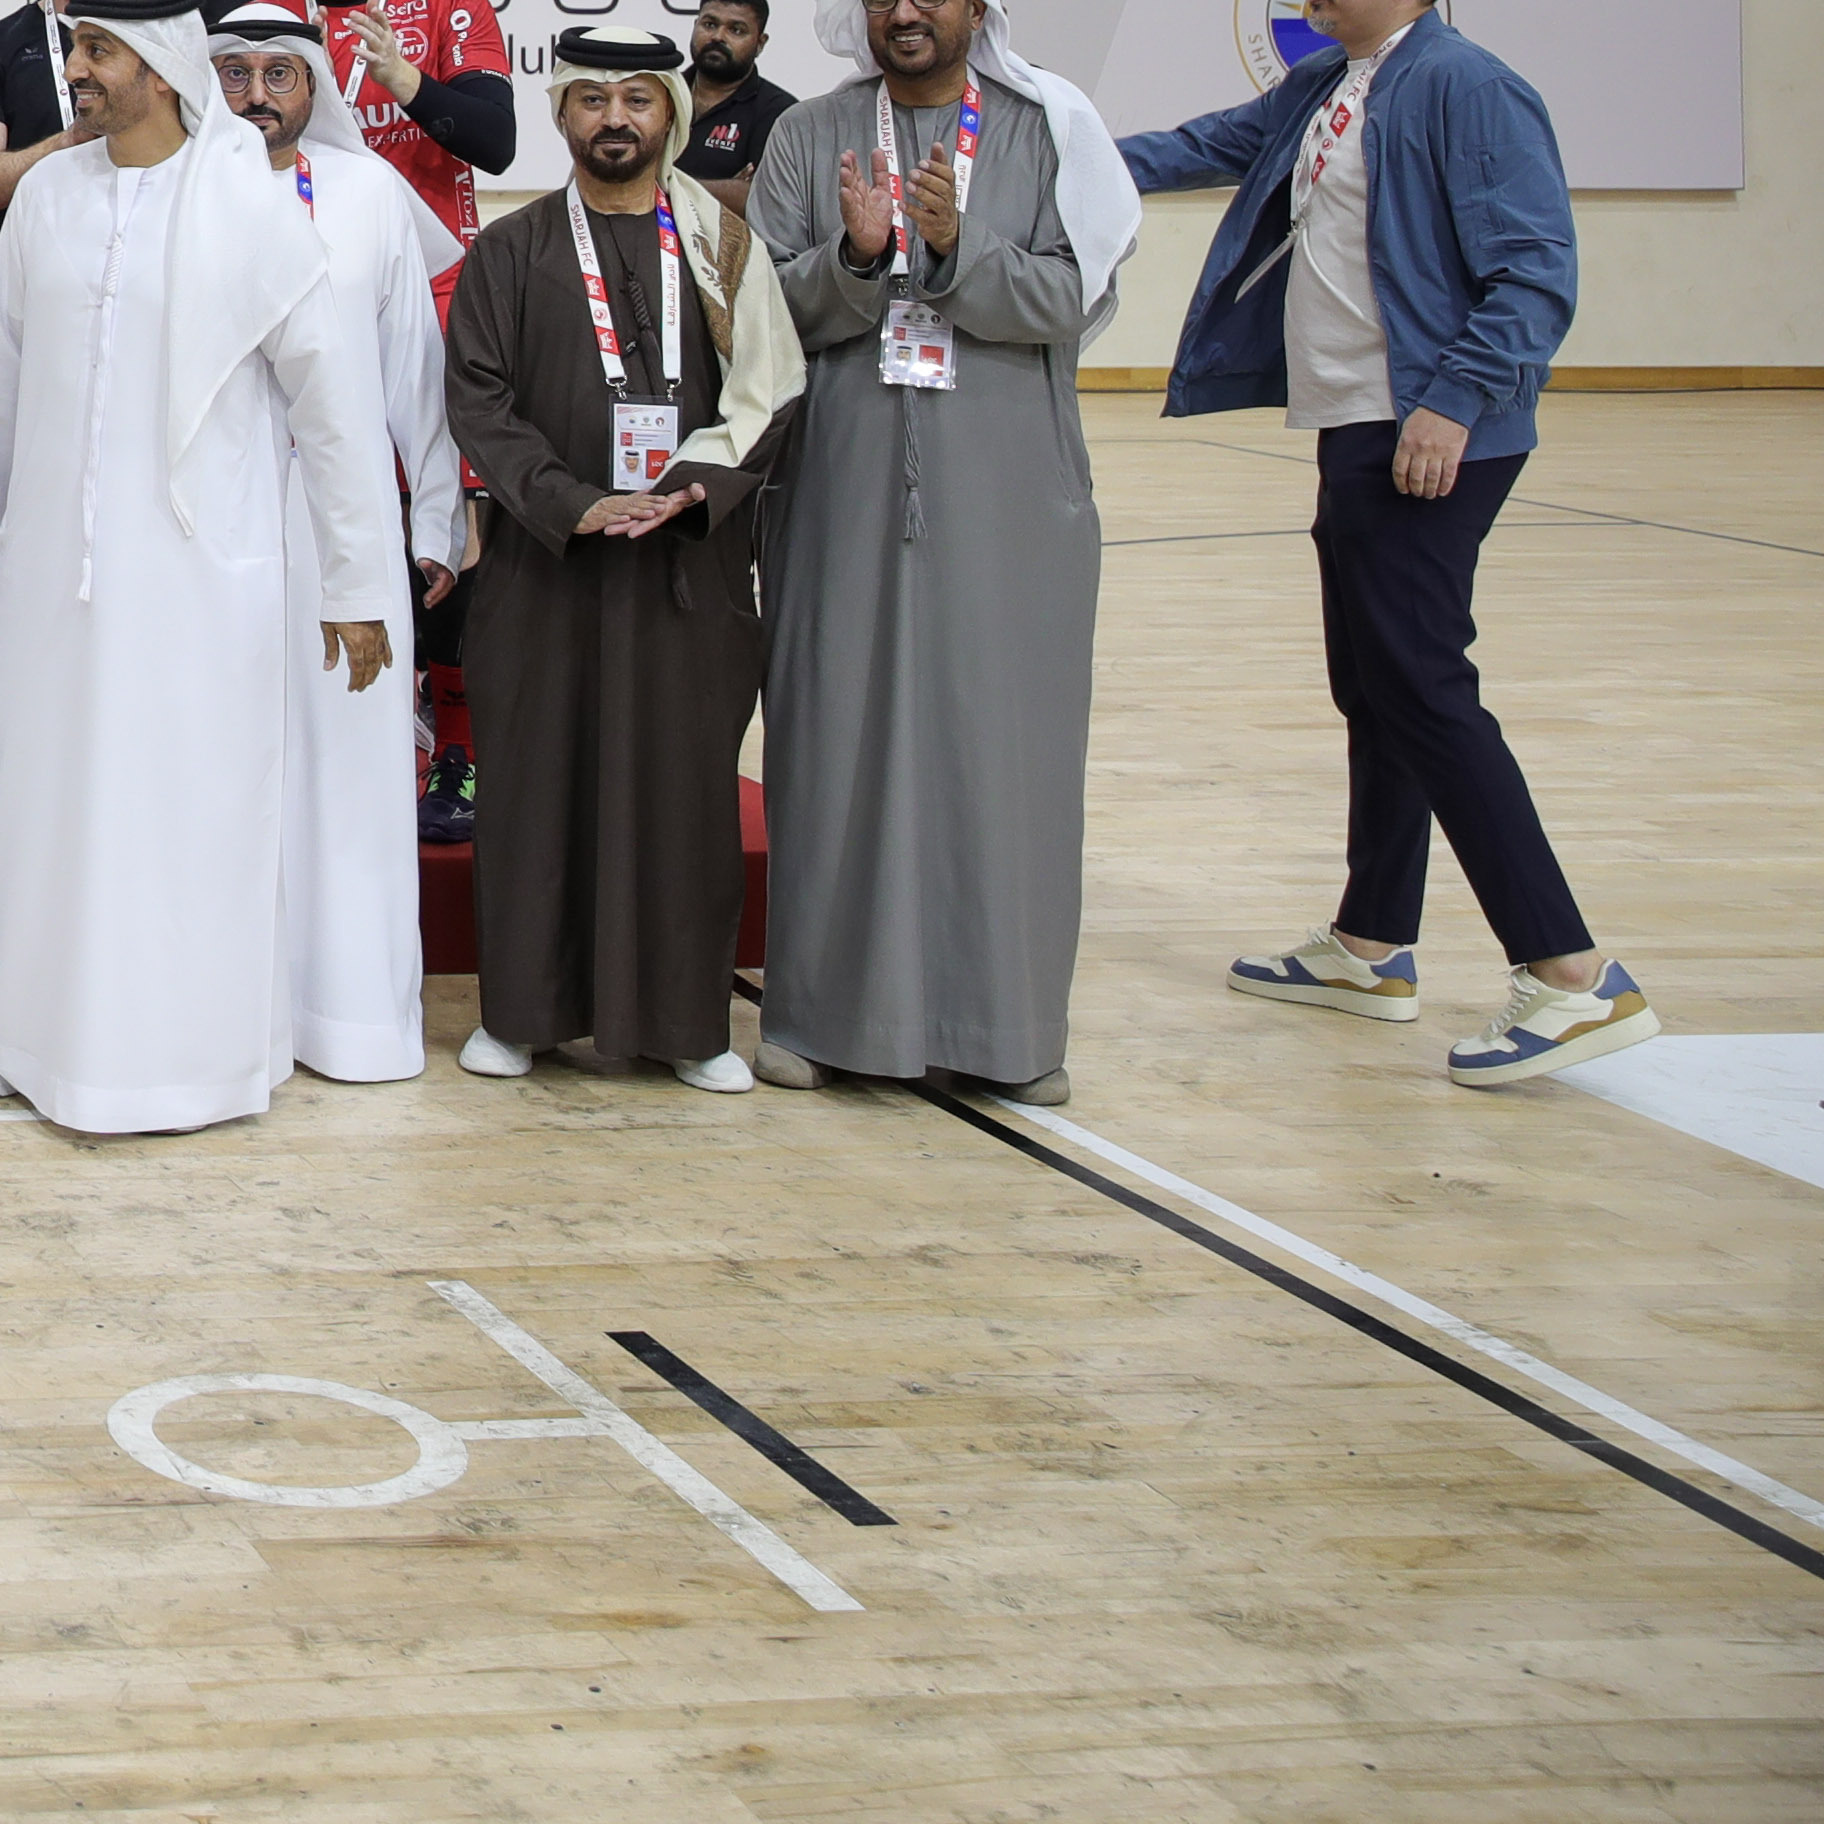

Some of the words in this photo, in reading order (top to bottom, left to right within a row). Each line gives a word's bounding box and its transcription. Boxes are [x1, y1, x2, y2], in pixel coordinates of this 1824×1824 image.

[1248, 33, 1282, 91] SHAR
[570, 204, 589, 251] SHARJAH
[581, 251, 594, 266] FC
